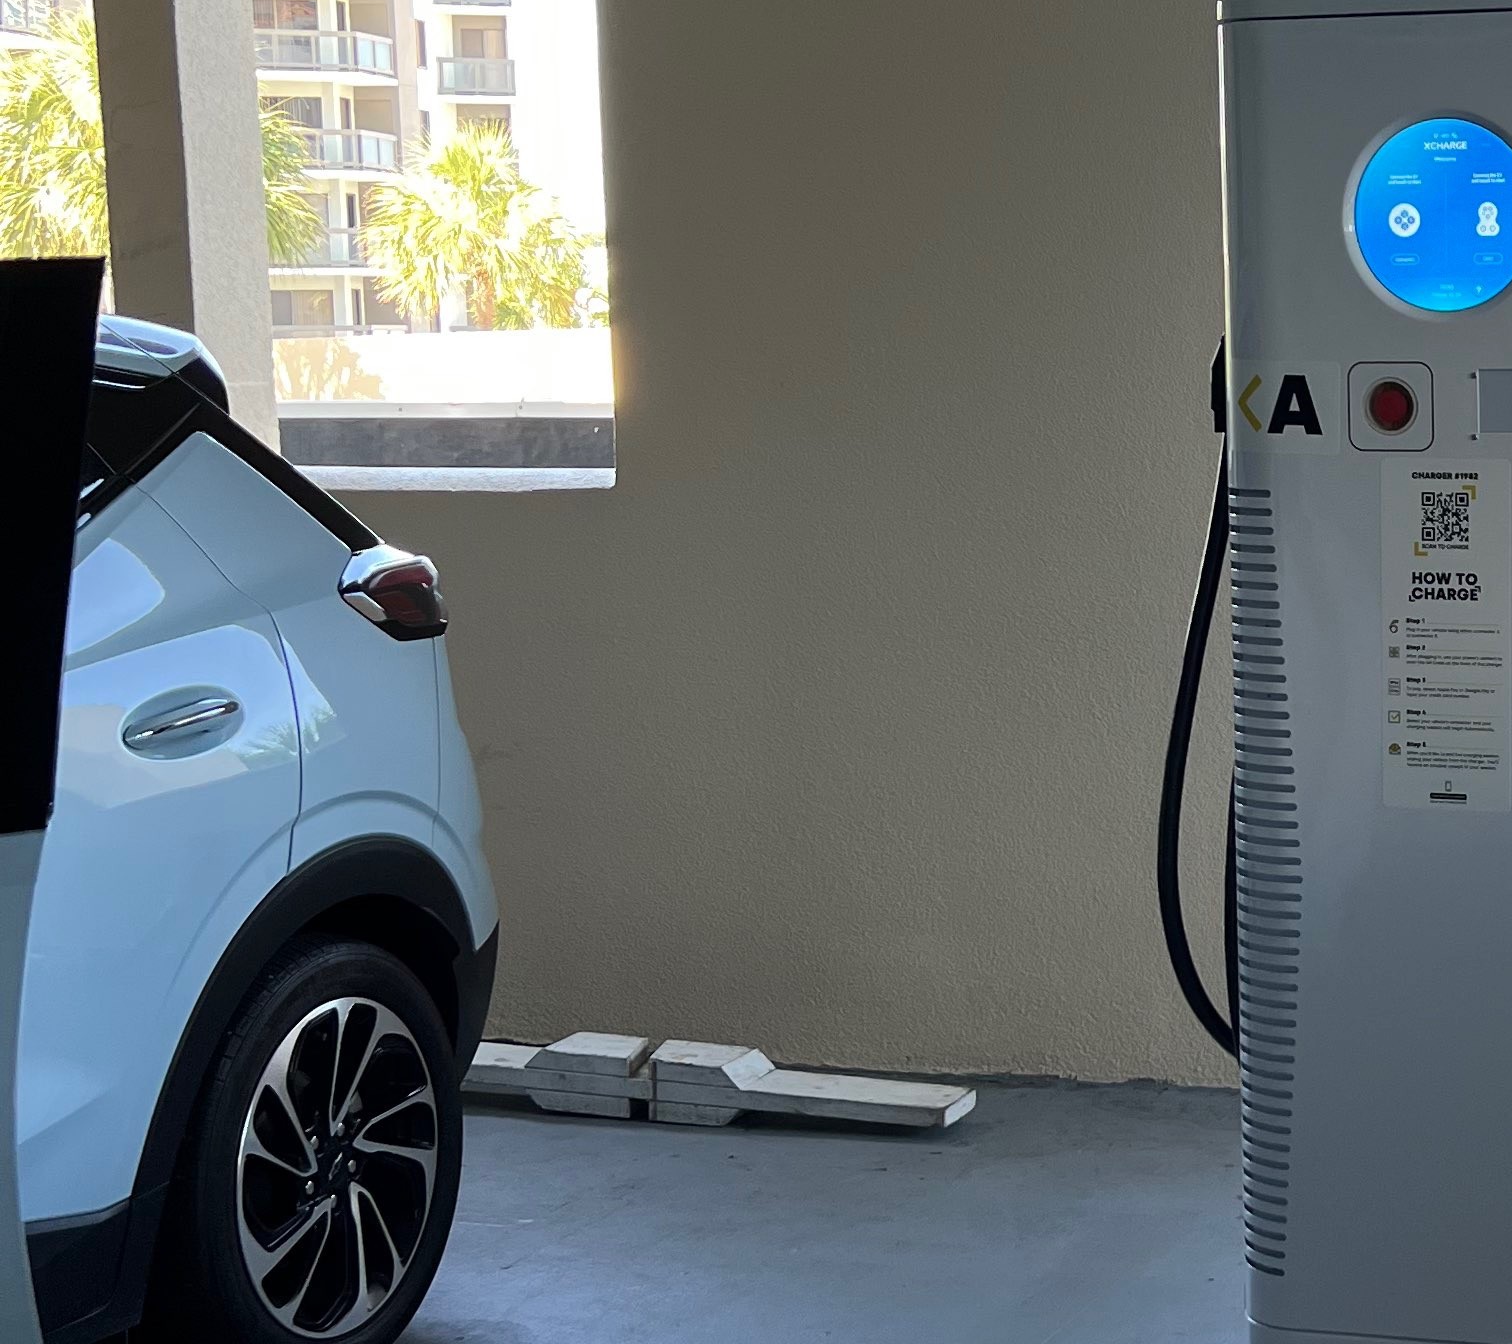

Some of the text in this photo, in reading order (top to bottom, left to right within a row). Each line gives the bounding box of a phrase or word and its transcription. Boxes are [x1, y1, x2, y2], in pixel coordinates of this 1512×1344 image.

[1423, 140, 1468, 150] XCHARGE
[1267, 374, 1323, 435] A
[1411, 471, 1453, 480] CHARGER
[1411, 571, 1478, 586] HOW TO
[1411, 586, 1479, 602] CHARGE
